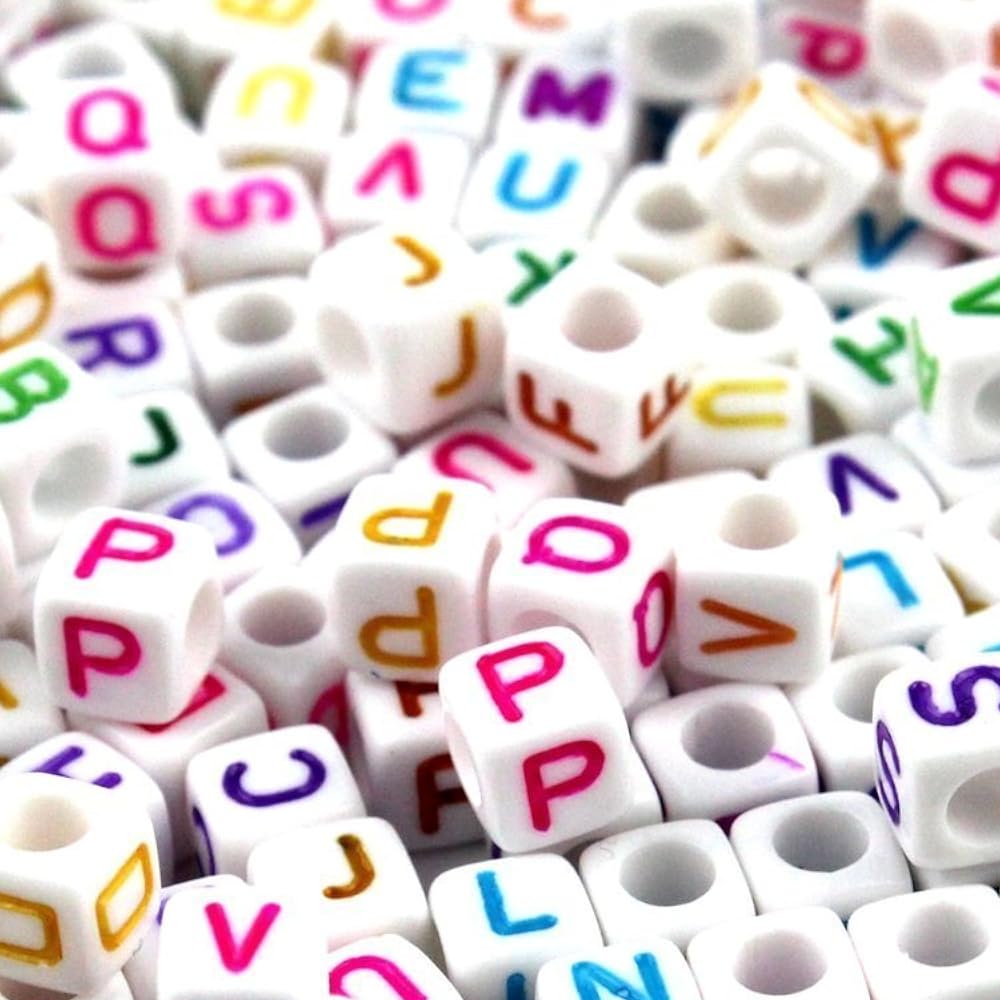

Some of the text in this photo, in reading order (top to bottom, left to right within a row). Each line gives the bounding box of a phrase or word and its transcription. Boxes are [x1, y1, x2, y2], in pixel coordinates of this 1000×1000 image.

[390, 48, 466, 115] E
[355, 139, 424, 202] V
[493, 150, 582, 215] U
[70, 181, 163, 267] Q
[189, 177, 297, 236] S
[64, 317, 162, 372] R
[432, 312, 481, 401] J
[517, 373, 597, 455] F
[71, 514, 178, 582] P
[519, 512, 634, 577] Q
[63, 615, 144, 698] P
[473, 639, 568, 726] P
[518, 736, 609, 835] P
[321, 832, 378, 902] J
[201, 900, 284, 977] V
[473, 867, 561, 940] L
